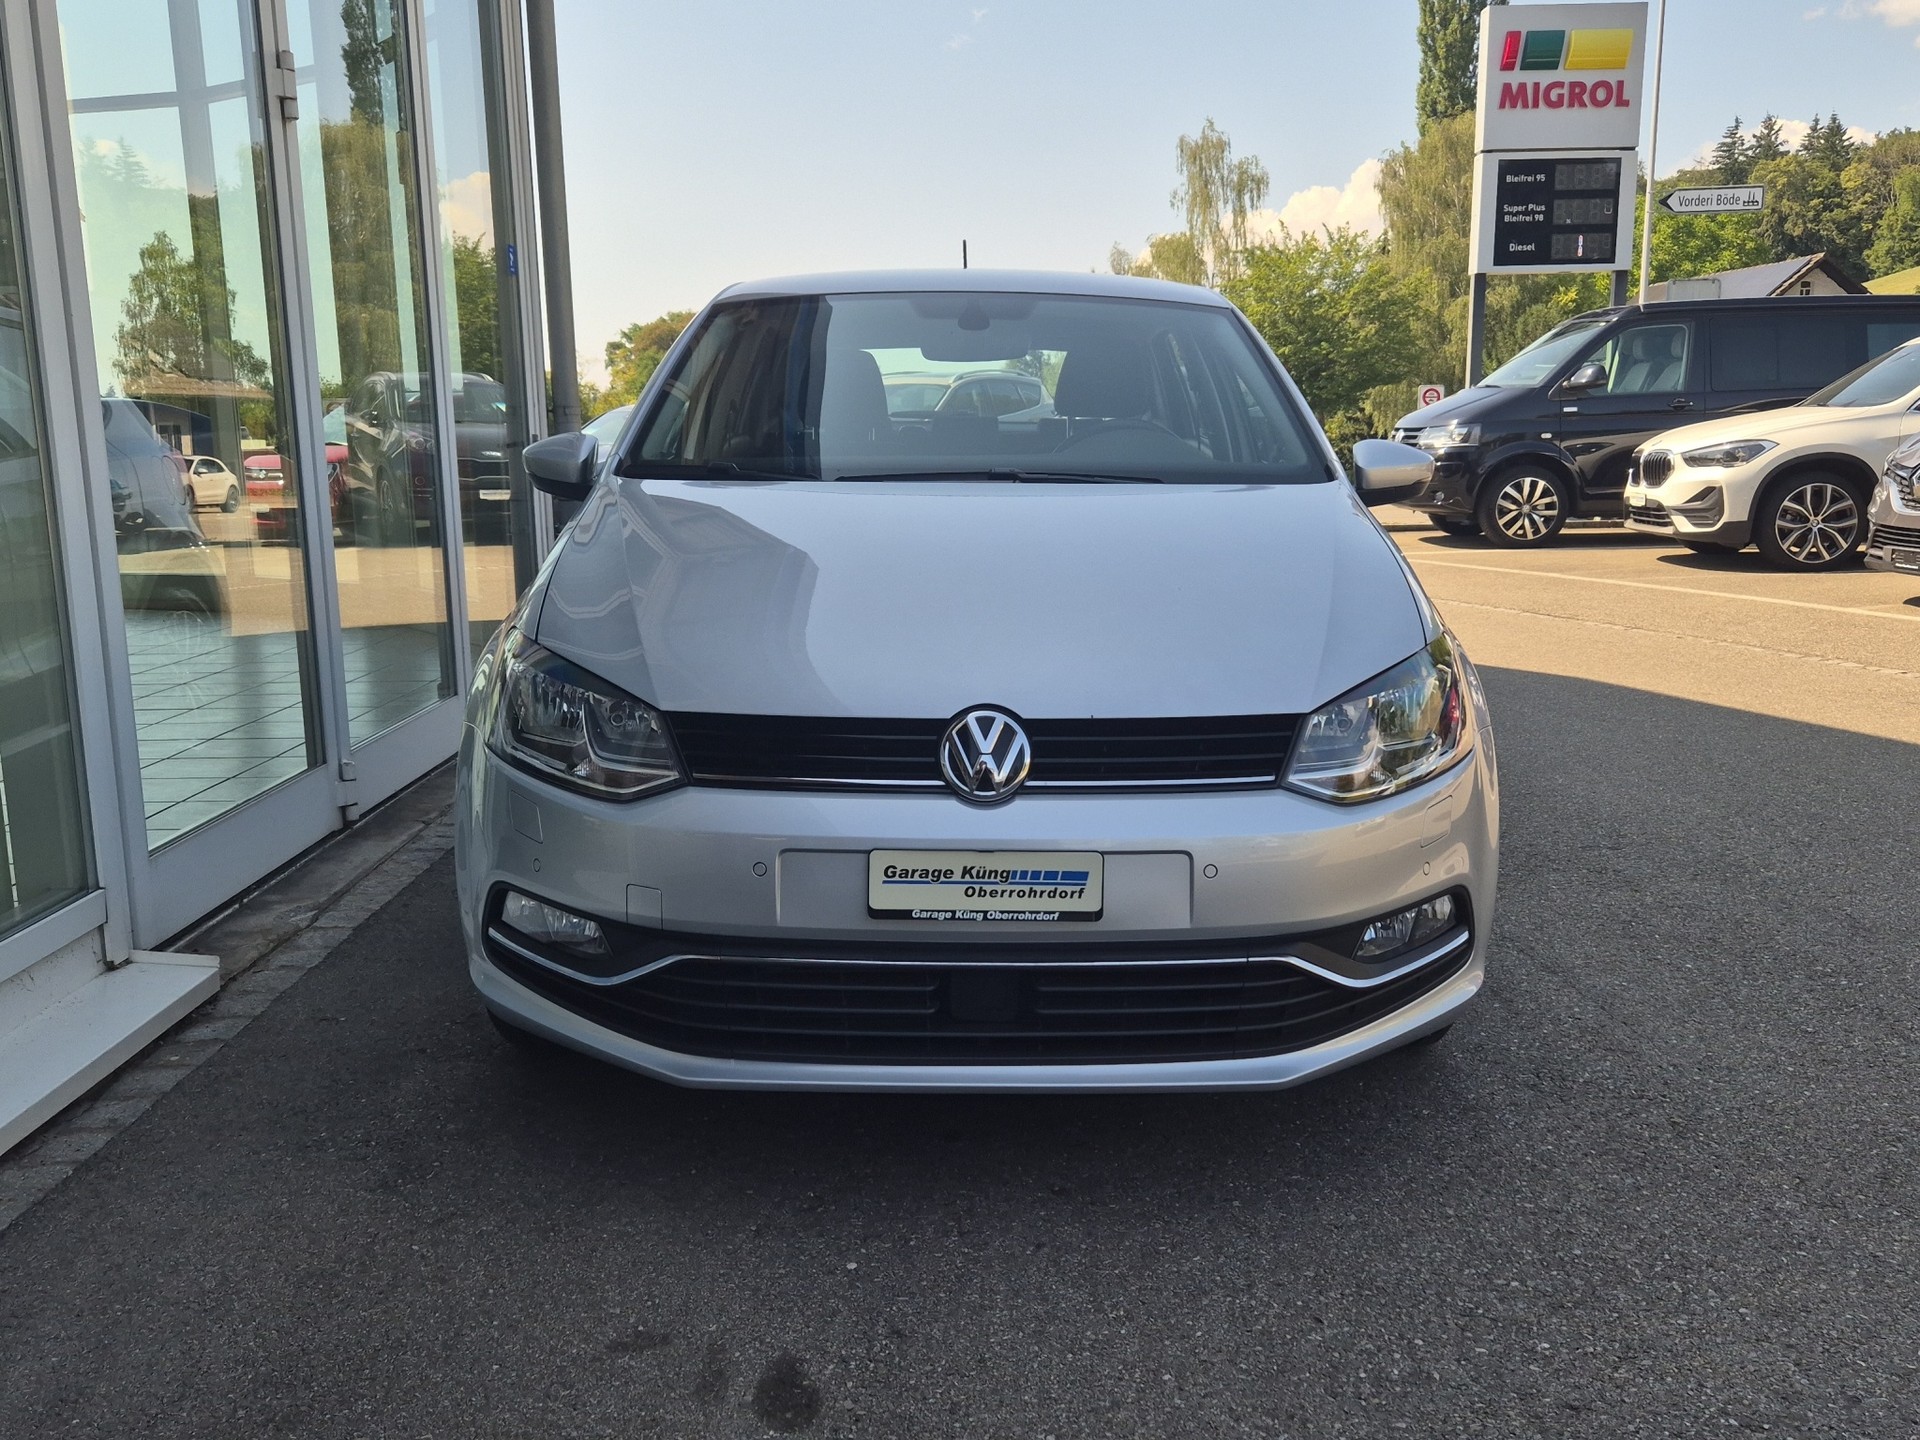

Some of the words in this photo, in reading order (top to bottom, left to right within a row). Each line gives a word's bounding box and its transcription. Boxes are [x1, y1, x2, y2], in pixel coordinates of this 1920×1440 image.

[1498, 80, 1630, 109] MIGROL
[1506, 174, 1535, 182] Bleifrei
[1678, 194, 1713, 207] Vorderi
[1716, 193, 1741, 206] Böde
[1503, 204, 1527, 213] Super
[1528, 203, 1546, 211] Plus
[1504, 214, 1533, 222] Bleifrei
[1509, 243, 1535, 252] Diesel
[941, 711, 1030, 801] VW
[883, 865, 954, 882] Garage
[961, 865, 1011, 883] Küng
[964, 886, 1085, 899] Oberrohrdorf
[912, 909, 952, 920] Garage
[955, 910, 983, 921] Küng
[987, 910, 1059, 921] Oberrohrdorf
